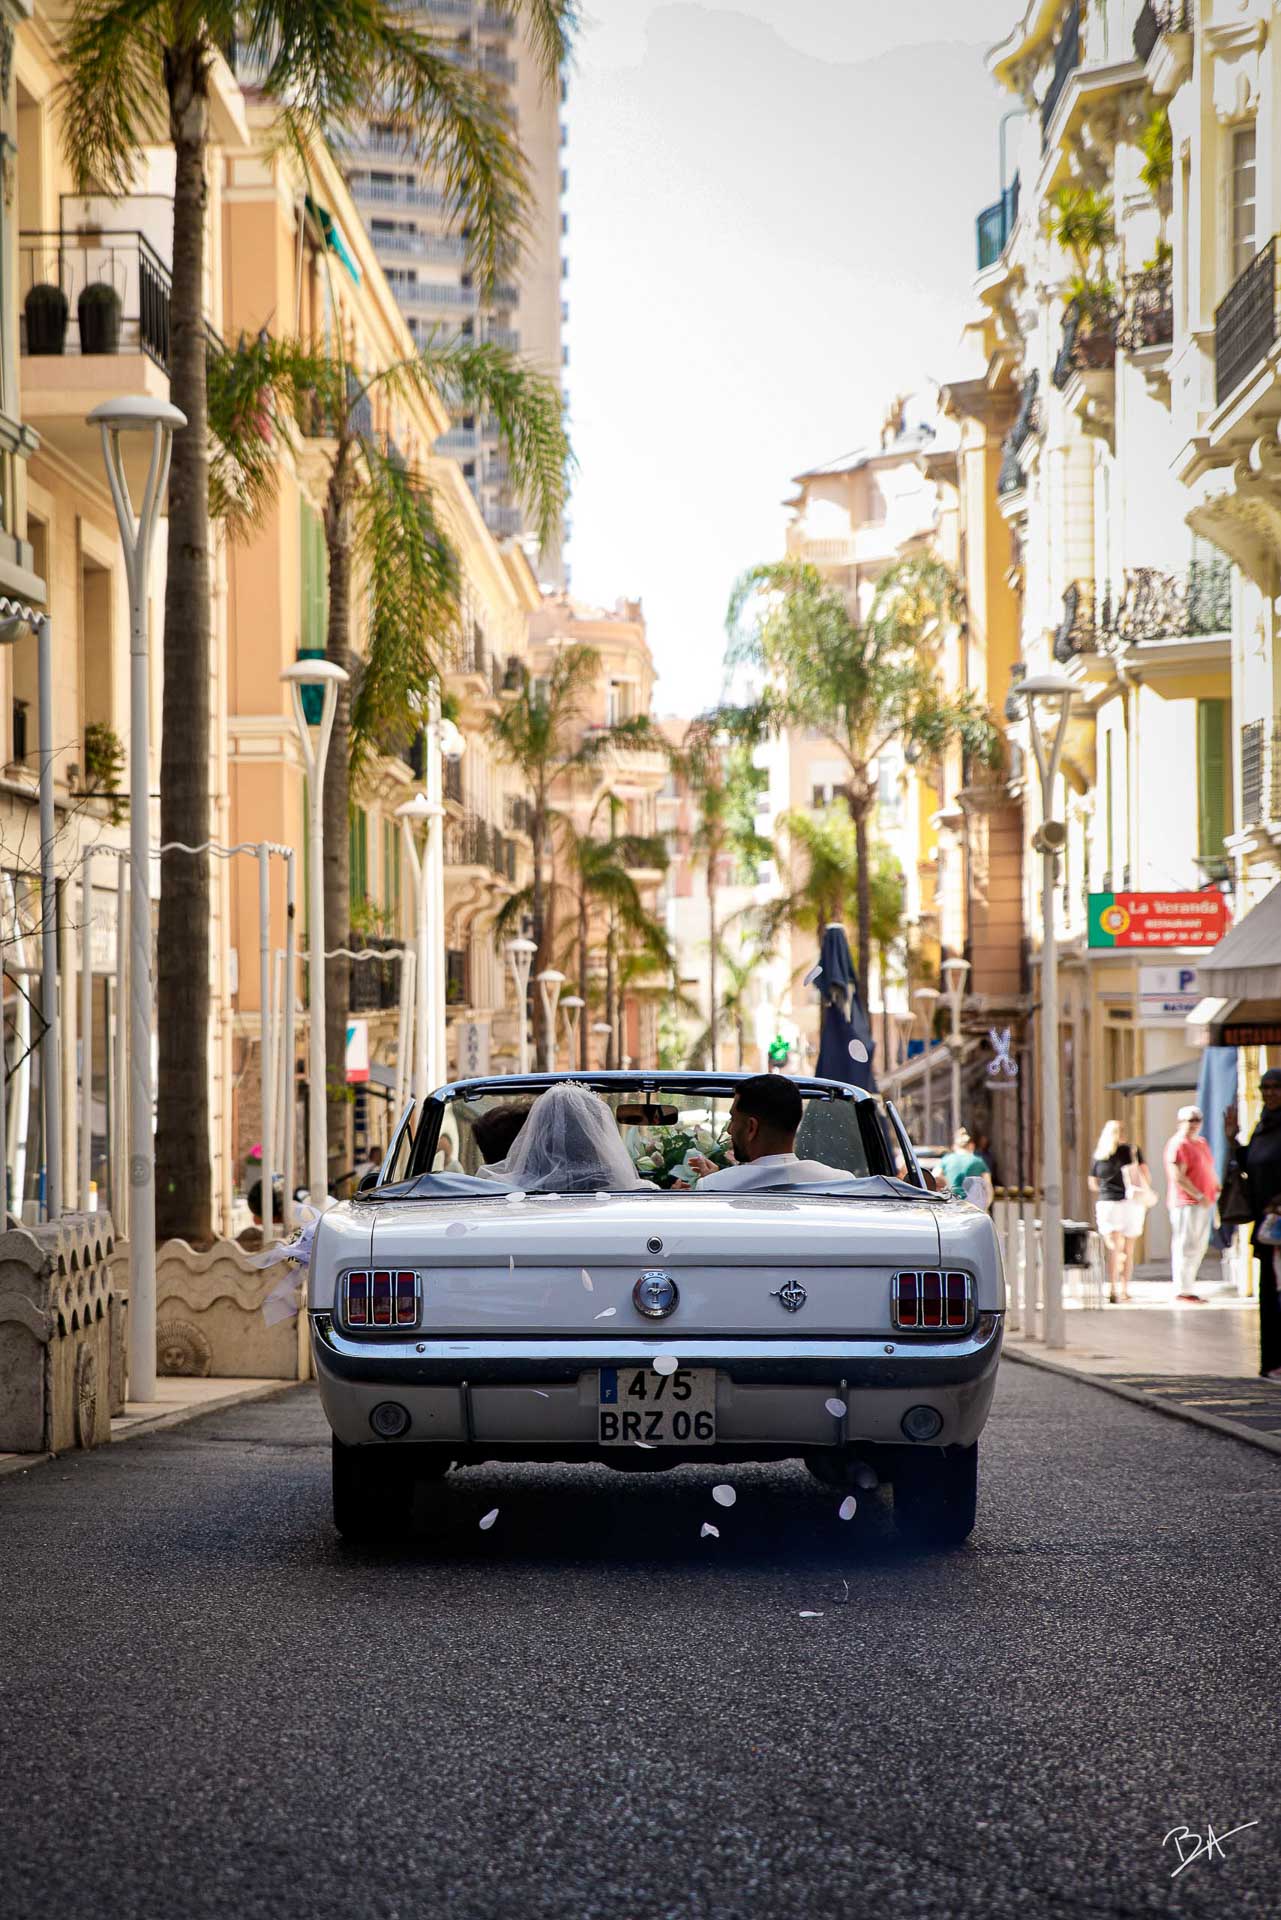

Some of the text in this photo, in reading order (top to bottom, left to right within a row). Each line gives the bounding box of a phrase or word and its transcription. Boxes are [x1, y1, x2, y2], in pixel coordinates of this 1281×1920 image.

[1129, 901, 1149, 914] La
[628, 1370, 692, 1400] 475
[600, 1411, 713, 1440] BRZ 06
